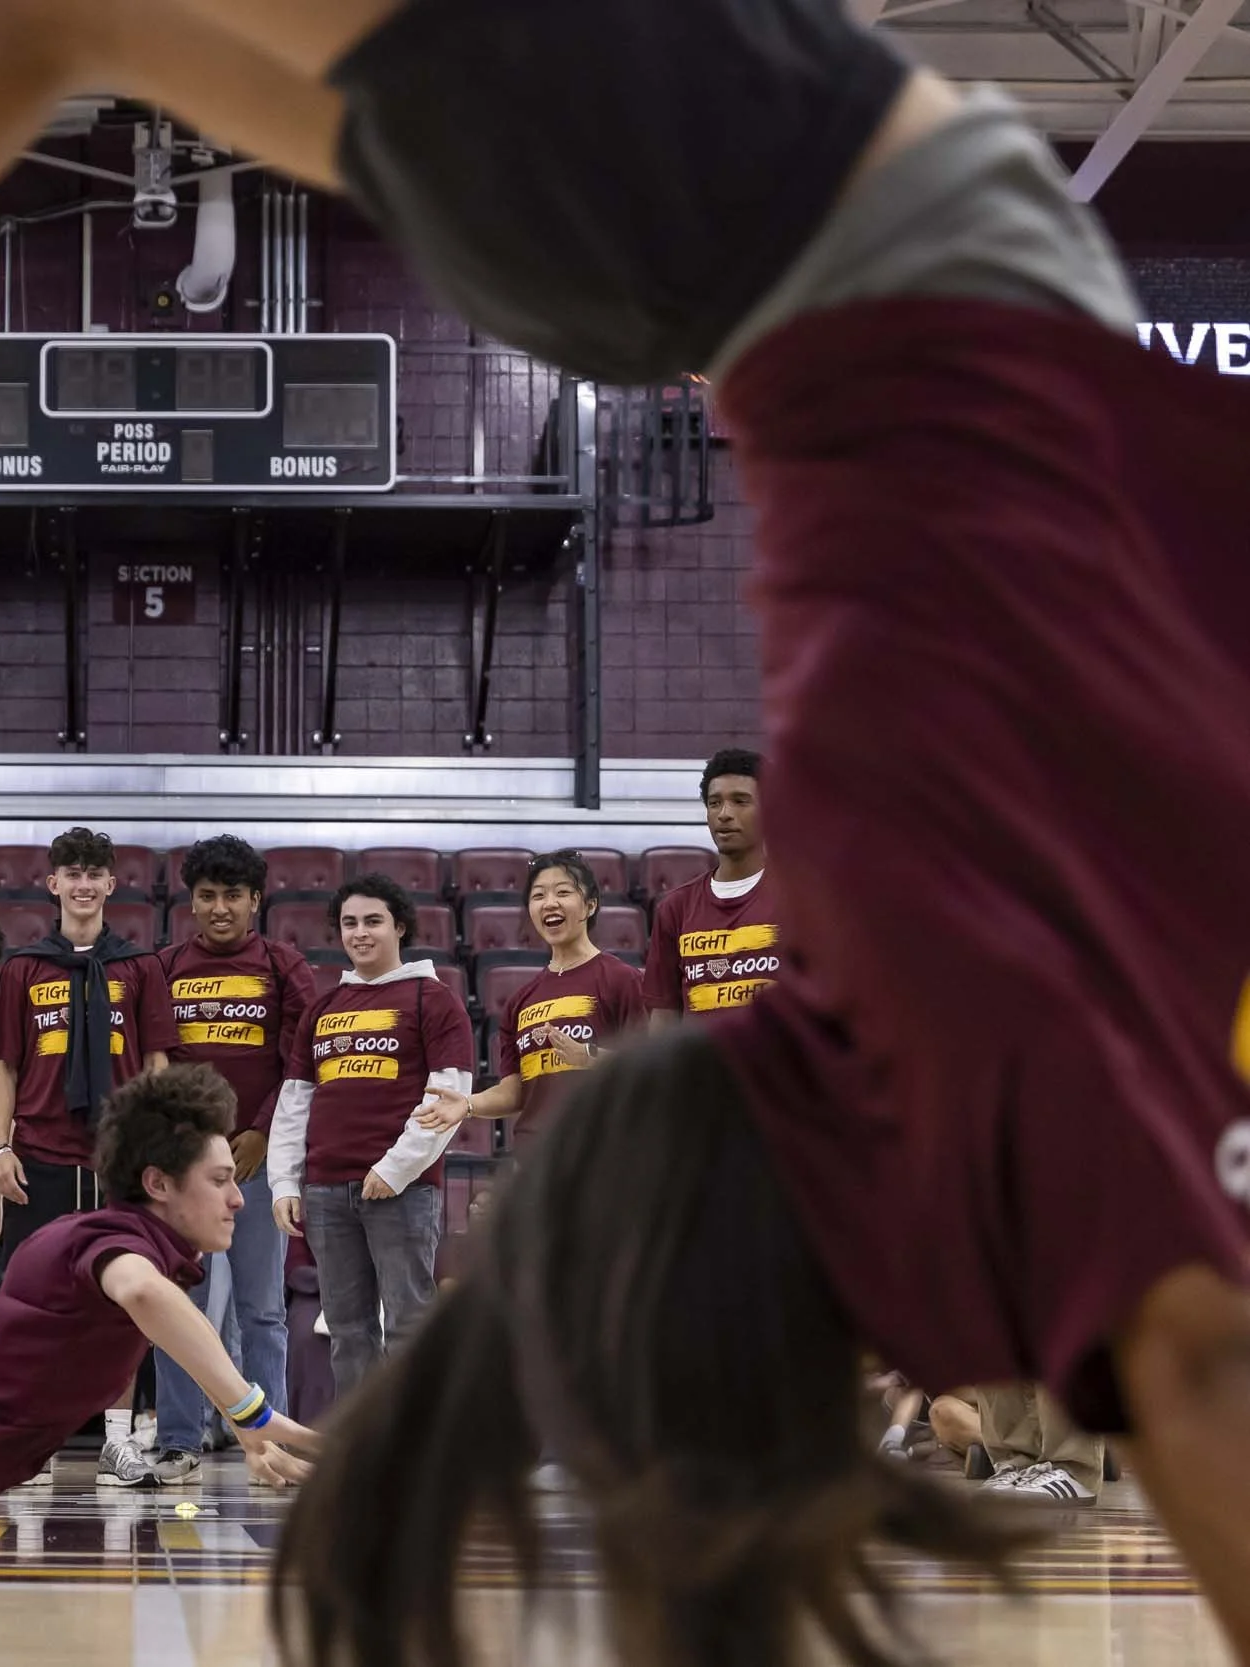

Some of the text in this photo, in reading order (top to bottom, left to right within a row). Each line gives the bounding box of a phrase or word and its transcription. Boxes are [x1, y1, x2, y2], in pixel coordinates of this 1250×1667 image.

[114, 423, 154, 439] POSS
[97, 442, 171, 463] PERIOD
[101, 464, 165, 473] FAIR-PLAY
[270, 456, 337, 477] BONUS
[145, 587, 163, 617] 5
[683, 934, 731, 954] FIGHT
[685, 963, 705, 983] HE
[732, 957, 780, 975] GOOD
[37, 986, 70, 1003] FIGH
[178, 980, 225, 996] FIGHT
[34, 1011, 59, 1029] THE
[173, 1005, 197, 1019] THE
[223, 1004, 267, 1019] GOOD
[519, 1002, 554, 1029] FIGHT
[207, 1024, 254, 1040] FIGHT
[319, 1014, 359, 1033] FIGHT
[313, 1040, 331, 1060] THE
[355, 1037, 399, 1052] GOOD
[338, 1059, 385, 1075] FIGHT
